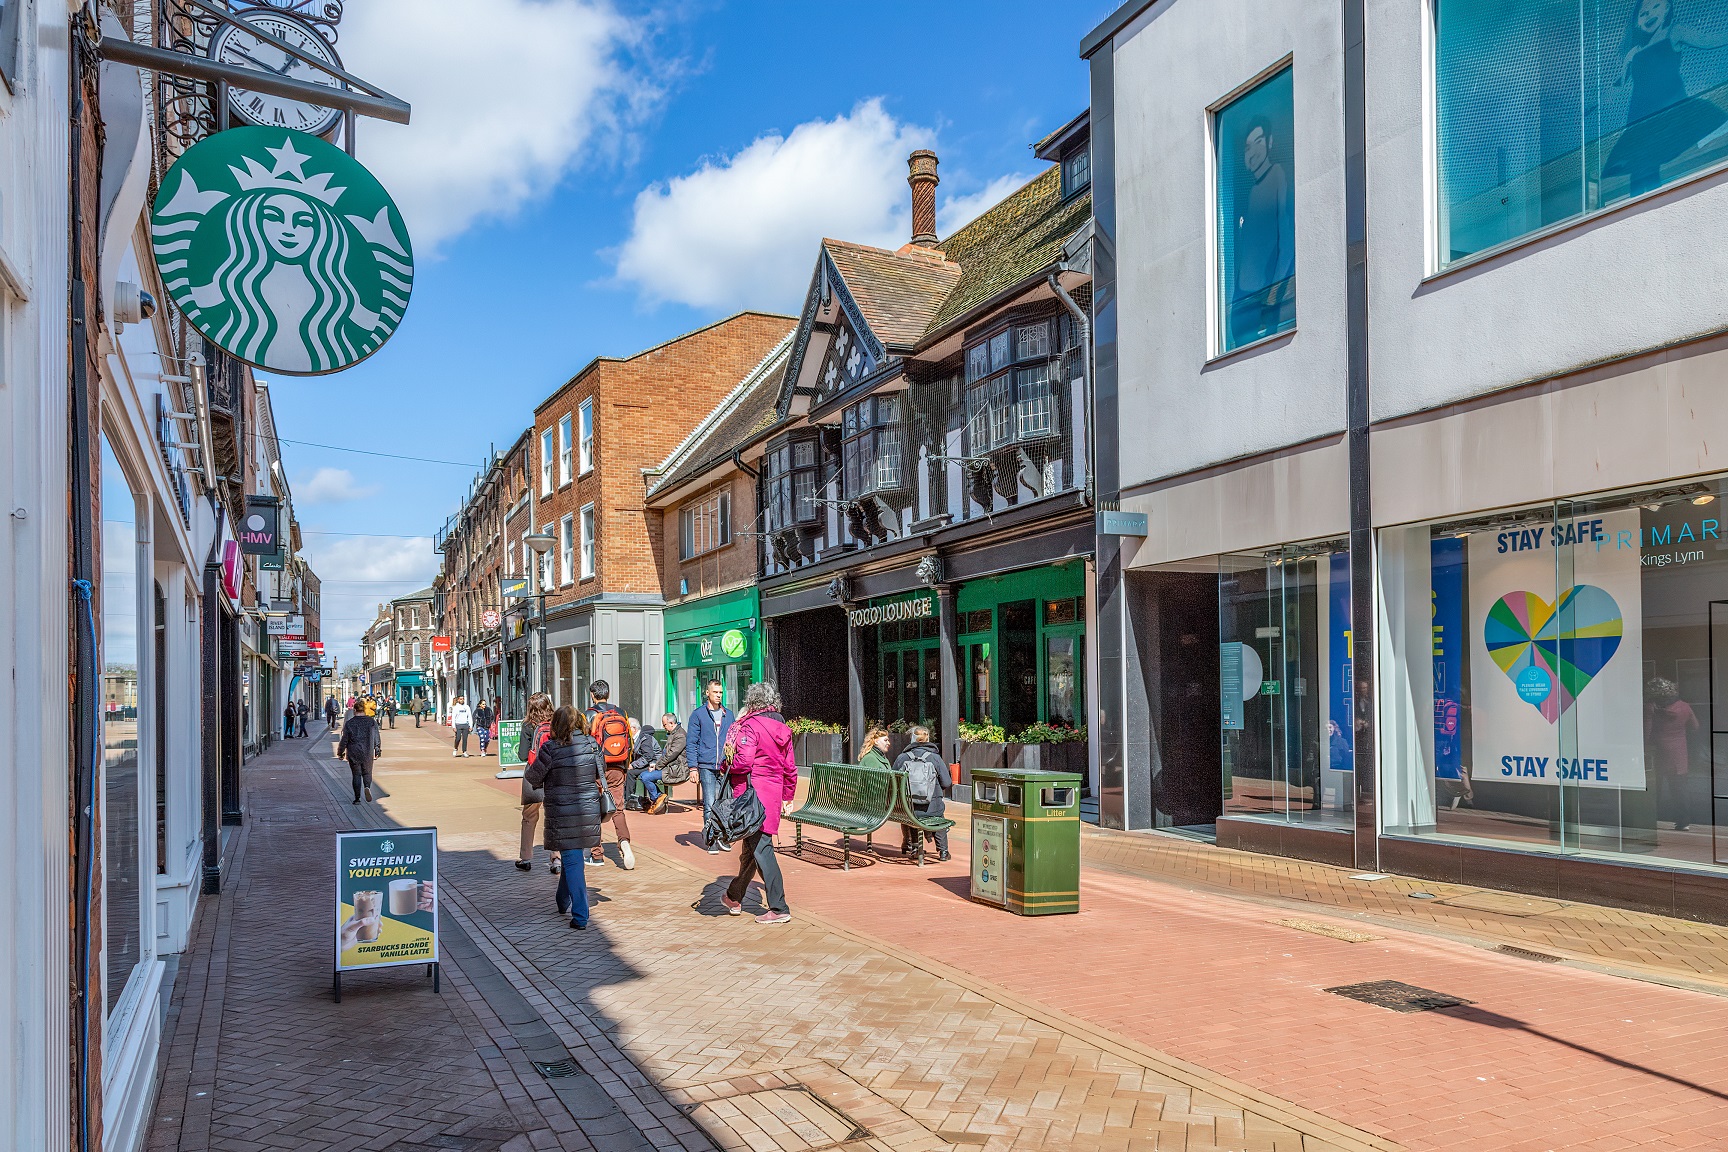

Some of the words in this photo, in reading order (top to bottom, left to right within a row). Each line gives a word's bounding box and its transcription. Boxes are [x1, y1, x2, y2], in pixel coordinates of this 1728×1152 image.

[240, 532, 272, 544] HMV
[1497, 527, 1544, 554] STAY
[1550, 519, 1604, 547] SAFE
[1639, 552, 1672, 567] Kings
[1675, 550, 1704, 565] Lynn
[503, 582, 527, 595] SUBWAY
[882, 596, 932, 622] LOUNGE
[1501, 755, 1549, 778] STAY
[1555, 757, 1609, 782] SAFE
[1046, 808, 1066, 817] Litter
[349, 856, 403, 868] SWEETEN
[406, 854, 422, 866] UP
[348, 867, 381, 879] YOUR
[383, 866, 417, 877] DAY...
[357, 943, 400, 953] STARBUCKS
[400, 941, 430, 950] BLONDE
[380, 949, 409, 958] VANILLA
[410, 947, 430, 956] LATTE
